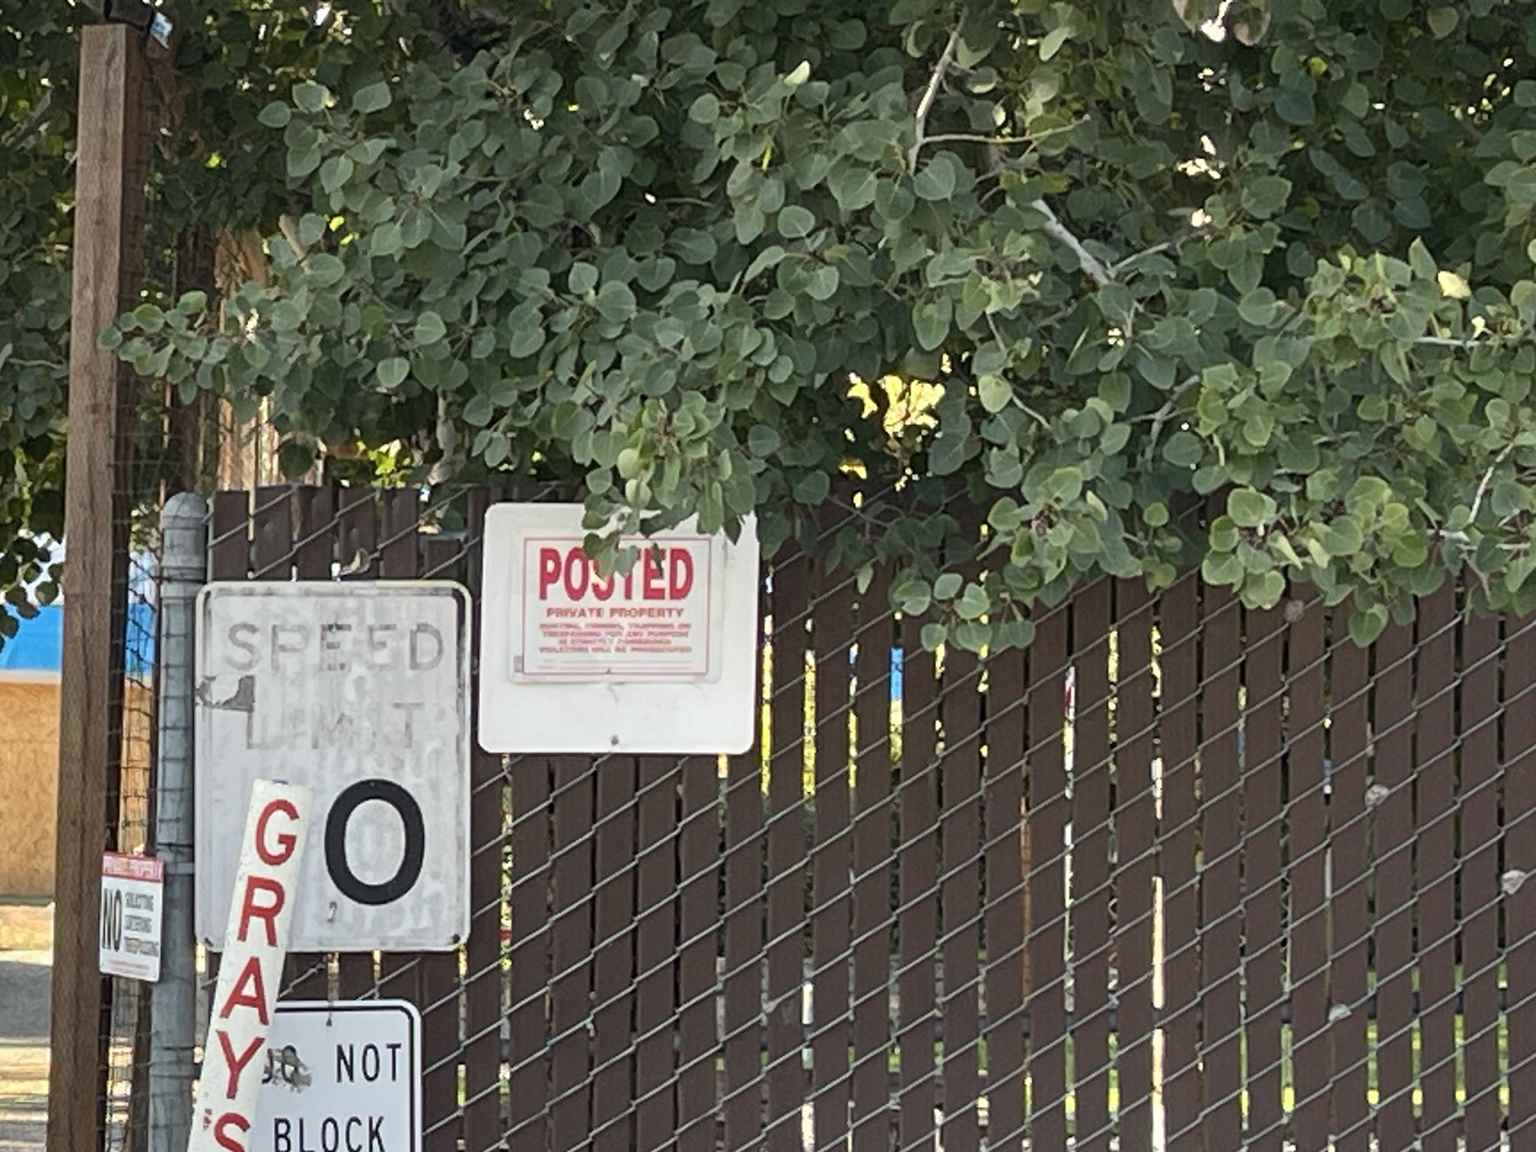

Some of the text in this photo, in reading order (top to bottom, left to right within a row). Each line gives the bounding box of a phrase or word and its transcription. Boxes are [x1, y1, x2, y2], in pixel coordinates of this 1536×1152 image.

[546, 607, 685, 618] PRIVATE PROPERTY
[225, 621, 444, 672] SPEED
[245, 700, 425, 750] LMT
[336, 1042, 402, 1083] NOT
